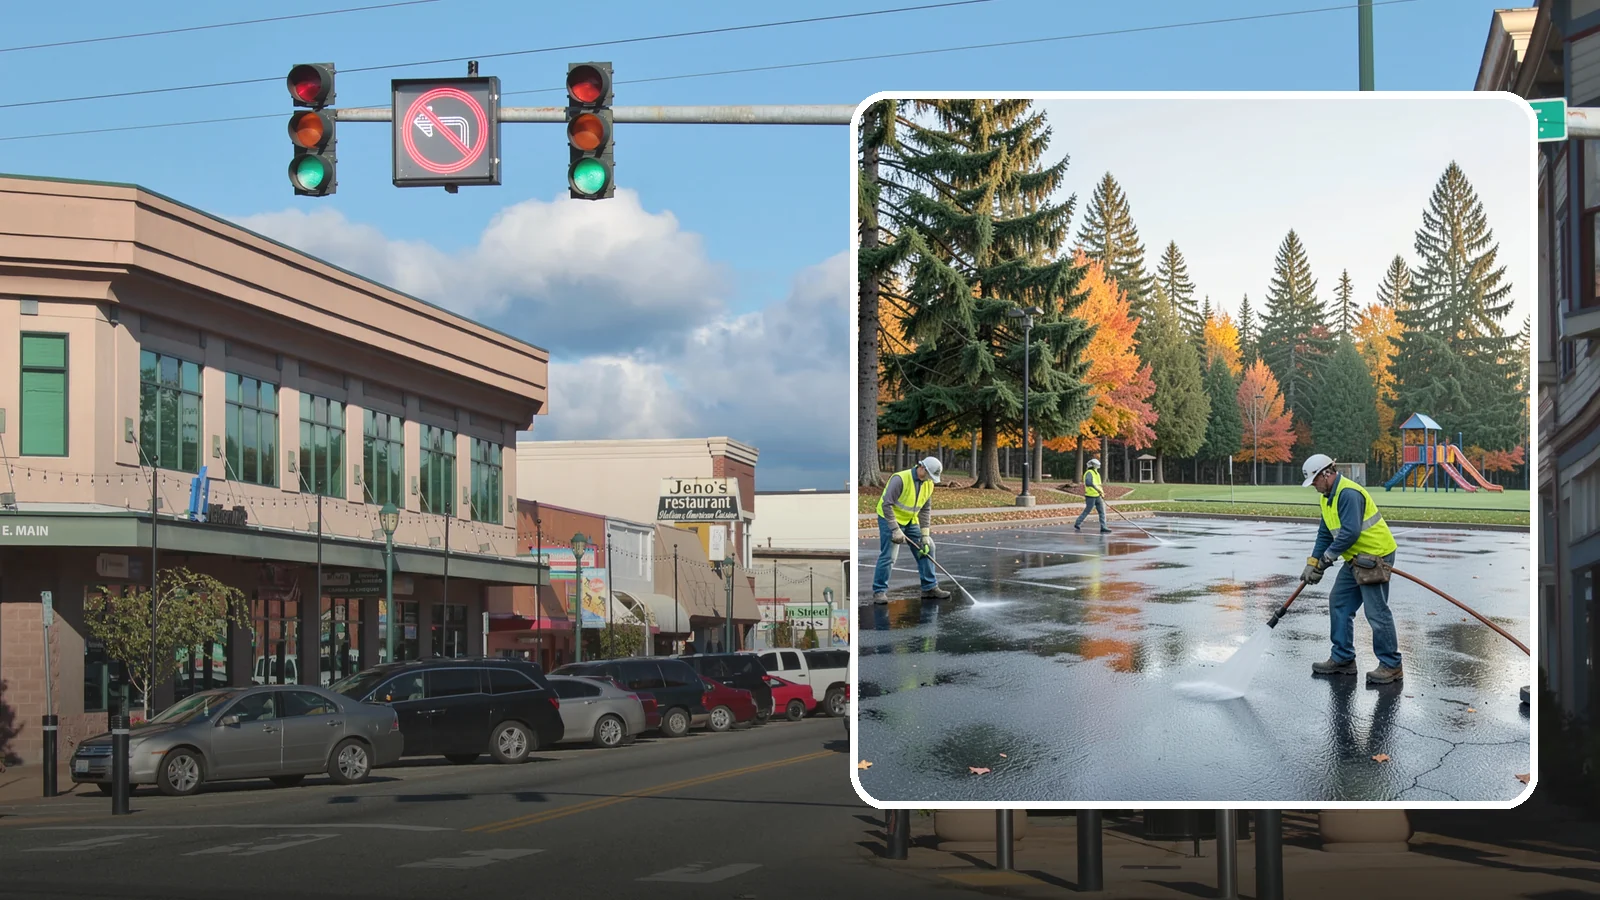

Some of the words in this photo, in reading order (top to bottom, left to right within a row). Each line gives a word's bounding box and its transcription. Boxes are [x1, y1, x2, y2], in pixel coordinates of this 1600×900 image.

[669, 480, 728, 495] Jeno's
[664, 496, 731, 509] restaurant
[658, 510, 682, 520] Italian
[686, 510, 714, 519] American
[715, 509, 737, 519] Cuisine
[2, 525, 13, 536] E.
[15, 525, 49, 536] MAIN
[797, 607, 828, 617] Street
[790, 619, 823, 627] lass
